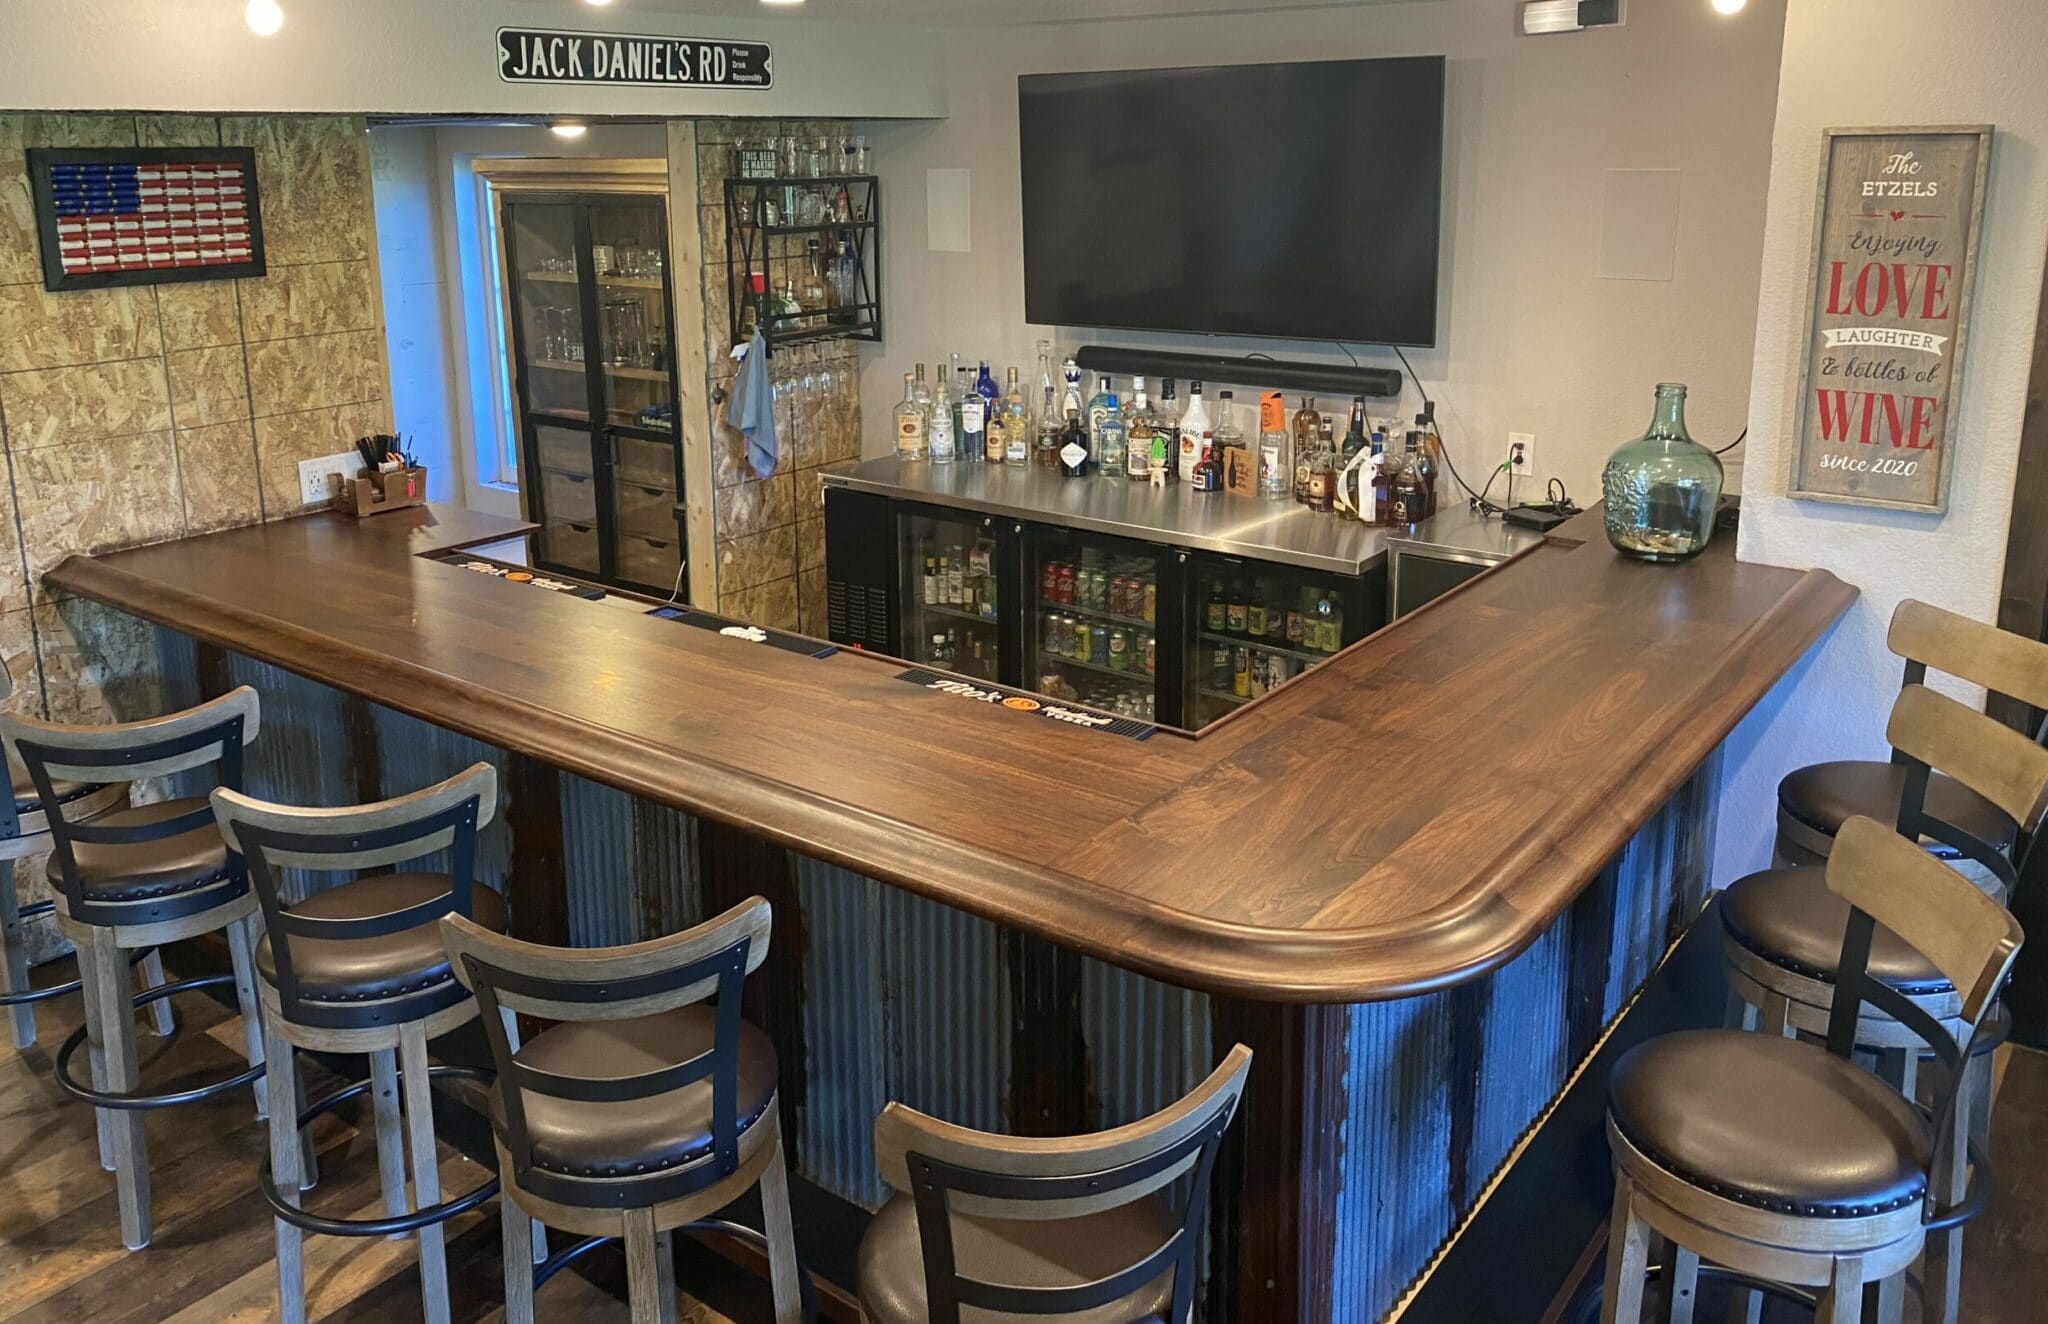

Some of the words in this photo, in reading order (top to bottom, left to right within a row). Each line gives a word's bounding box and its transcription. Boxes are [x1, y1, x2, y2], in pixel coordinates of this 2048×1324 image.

[513, 36, 584, 77] JACK
[699, 46, 726, 82] RD
[732, 48, 749, 57] Please
[732, 61, 746, 69] Drink
[732, 73, 762, 83] Responsibly
[742, 151, 757, 161] THIS
[759, 151, 776, 161] BEER
[742, 160, 750, 169] IS
[751, 160, 776, 170] MAKING
[1882, 151, 1922, 174] The
[1862, 181, 1938, 197] ETZELS
[1849, 231, 1942, 257] Enjoying
[1825, 261, 1952, 320] LOVE
[1836, 330, 1933, 349] LAUGHTER
[1822, 356, 1841, 376] &
[1845, 356, 1909, 382] bottles
[1914, 363, 1941, 383] of
[1816, 388, 1937, 450] WINE
[1820, 454, 1870, 473] since
[1871, 458, 1918, 476] 2020
[926, 680, 1002, 702] Tito's
